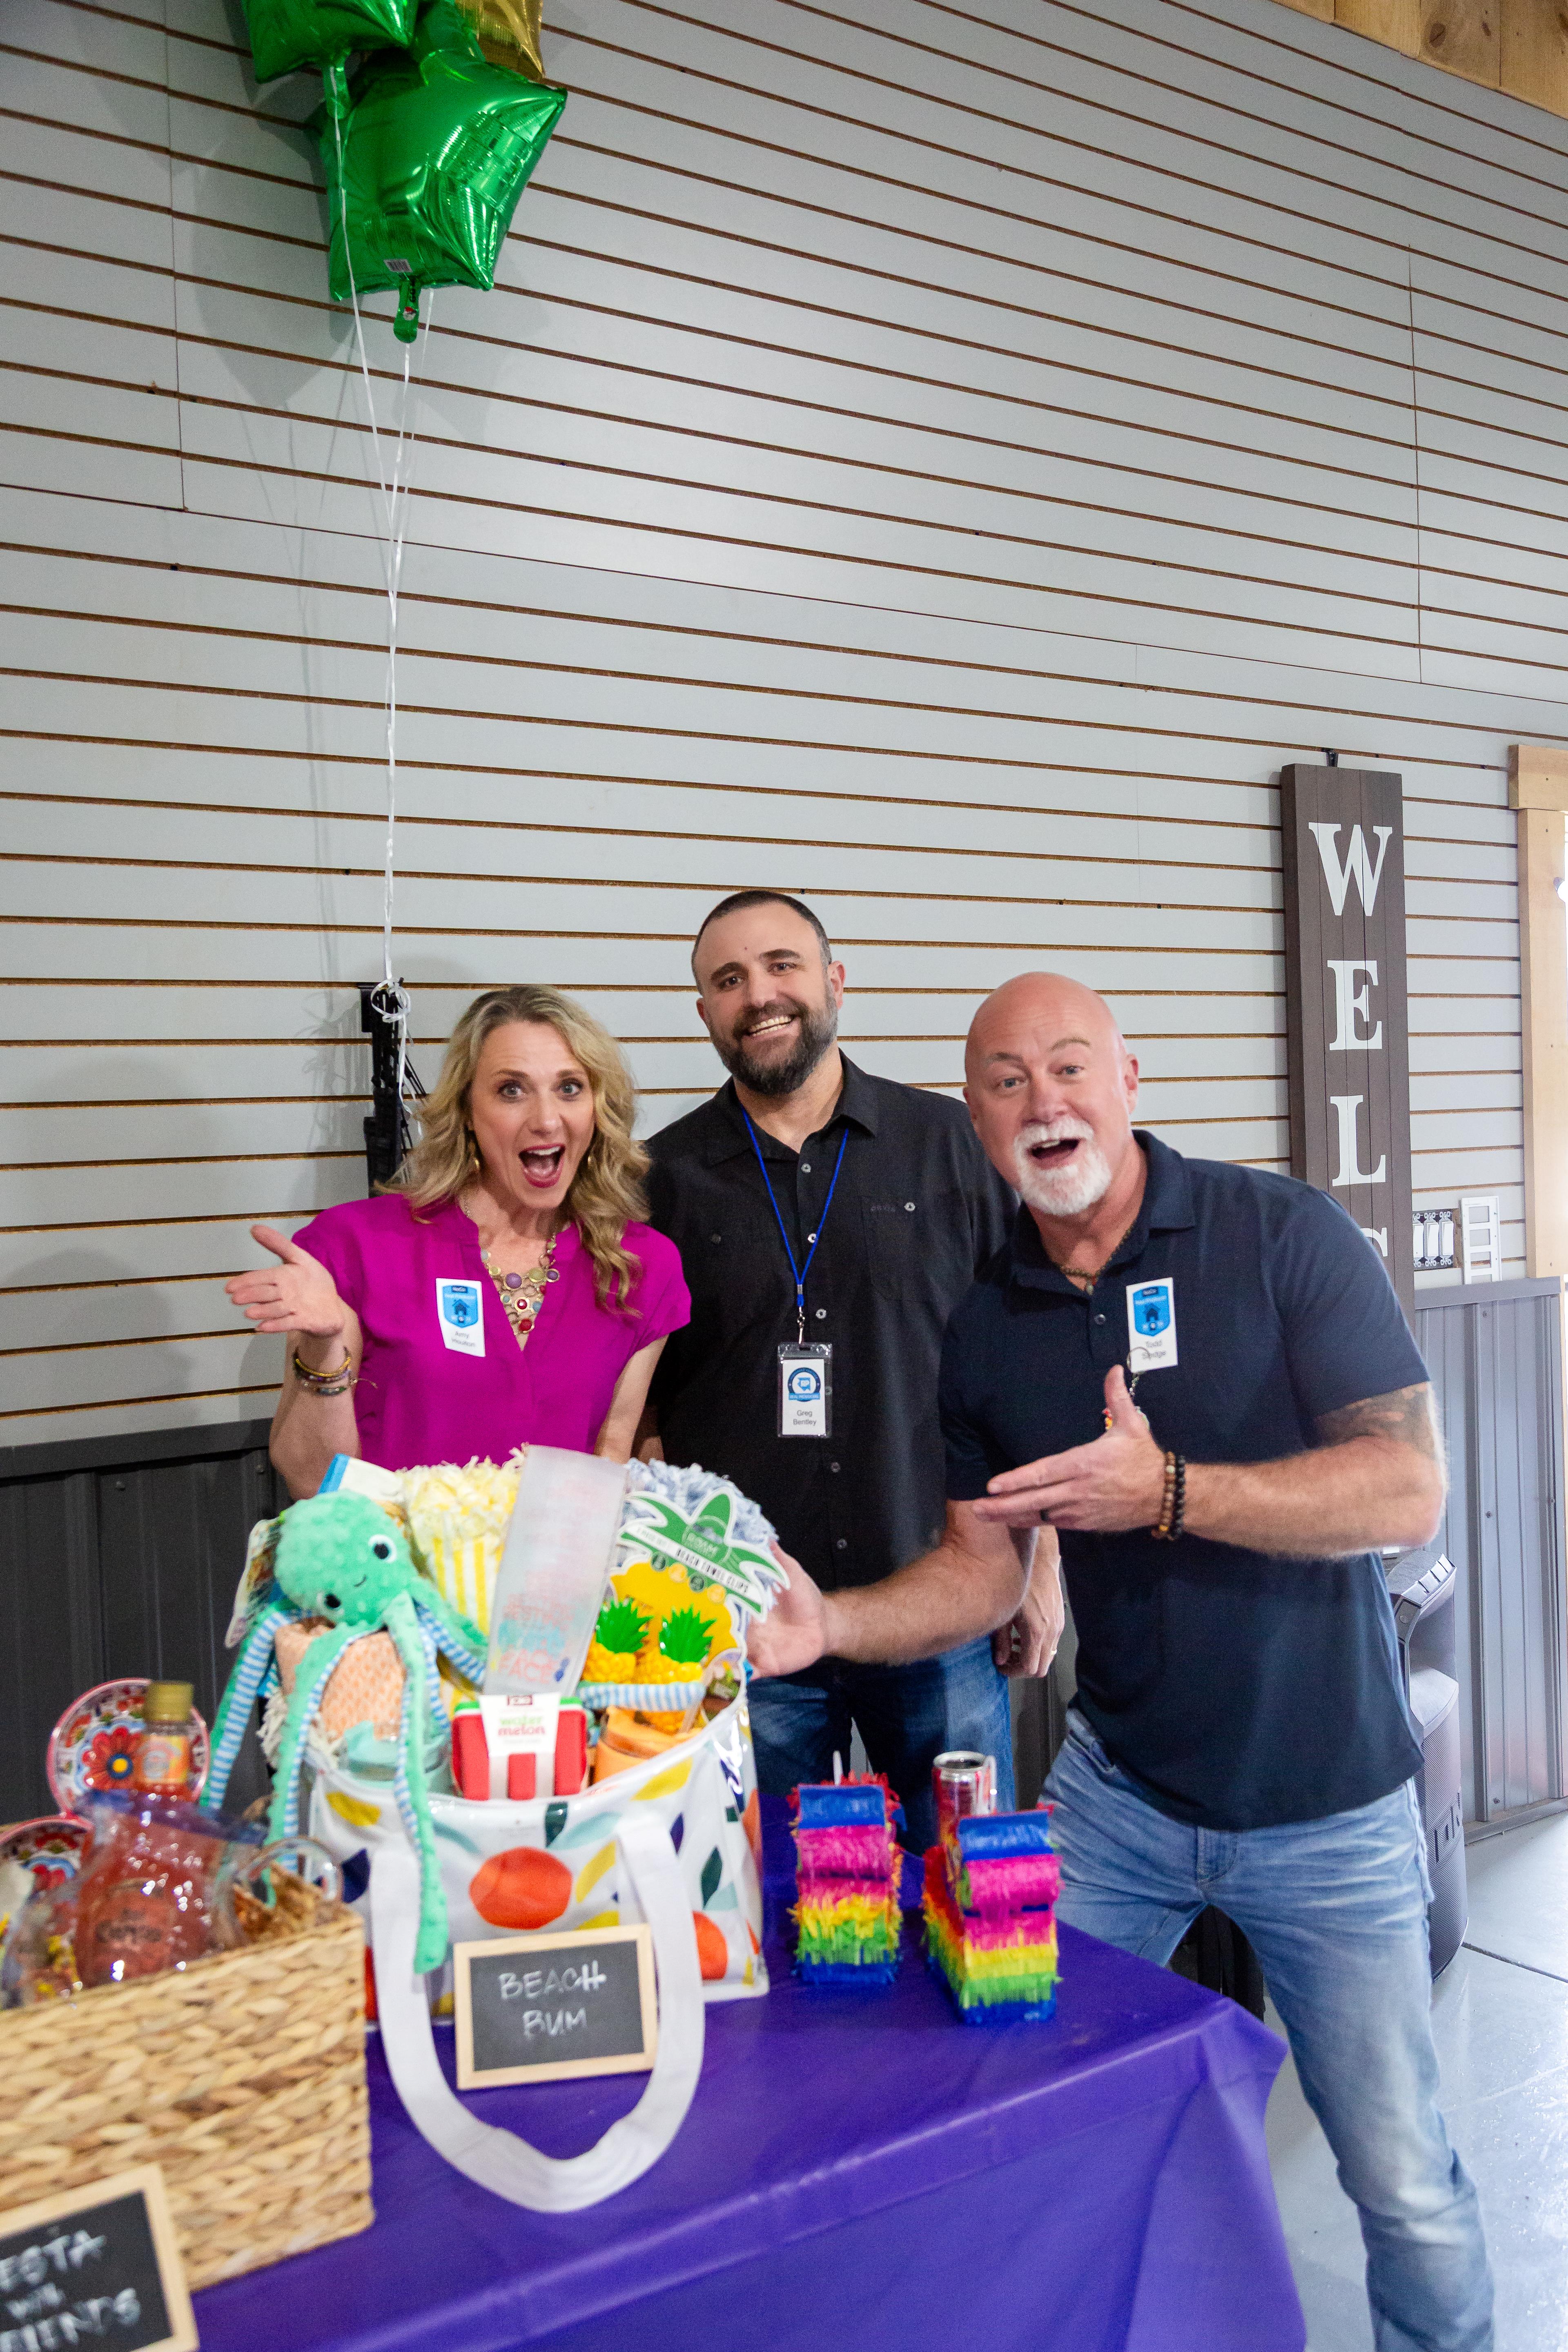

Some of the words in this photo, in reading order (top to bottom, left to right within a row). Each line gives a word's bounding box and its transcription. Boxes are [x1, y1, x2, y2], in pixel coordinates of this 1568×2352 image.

[1308, 822, 1393, 1257] WEL
[498, 1724, 546, 1736] melon
[499, 1716, 544, 1726] water
[498, 1960, 607, 2000] BEACH
[522, 2007, 588, 2040] BUM
